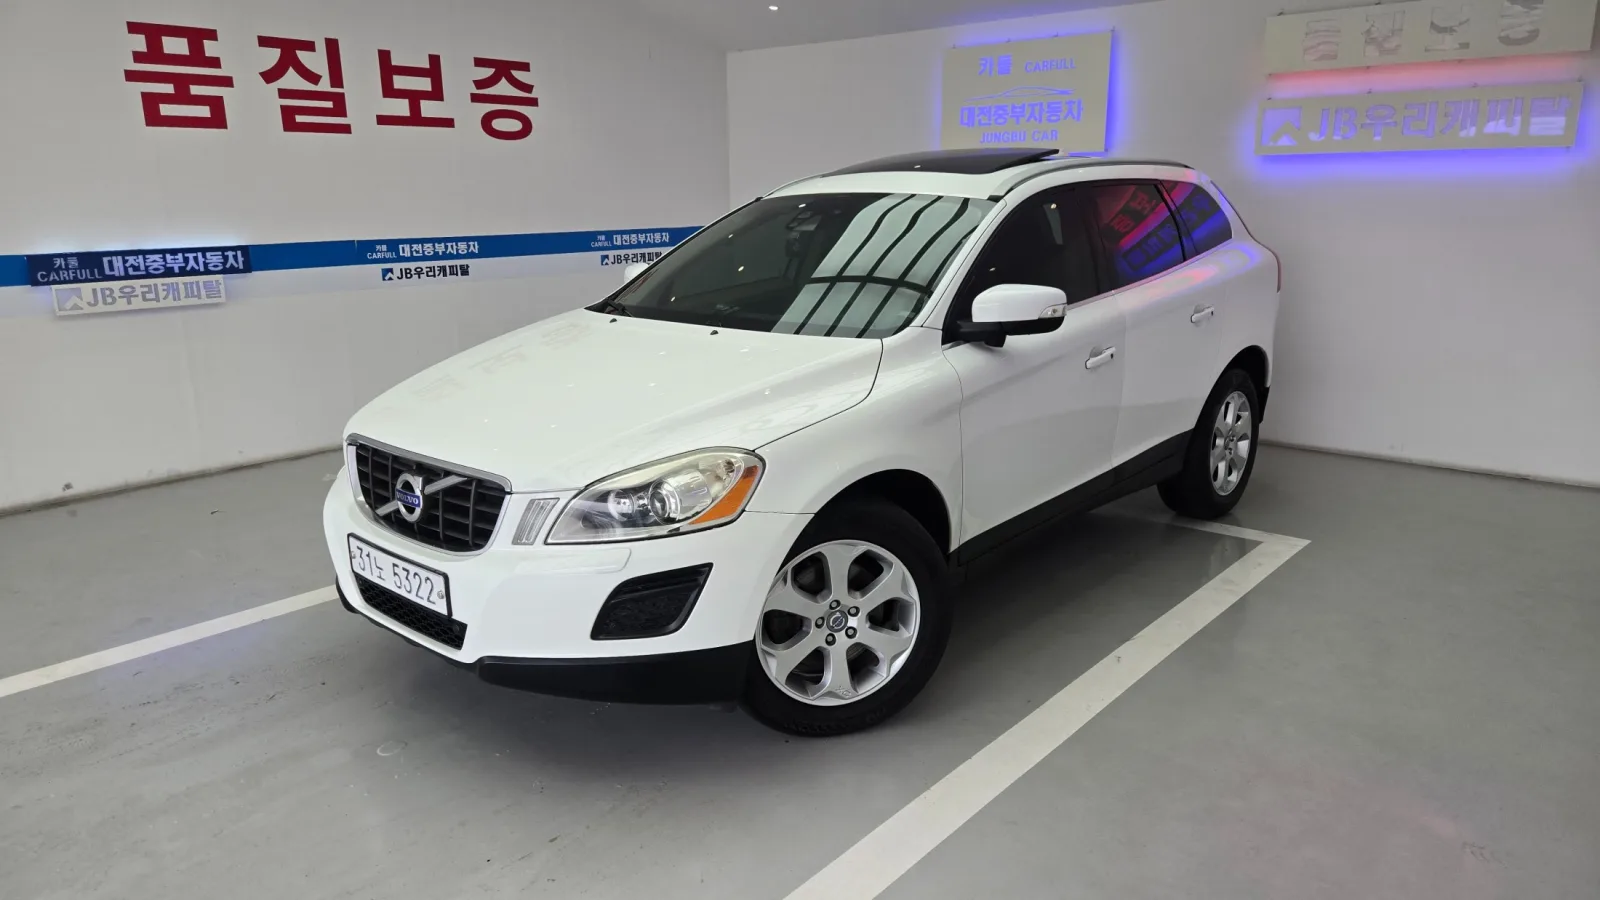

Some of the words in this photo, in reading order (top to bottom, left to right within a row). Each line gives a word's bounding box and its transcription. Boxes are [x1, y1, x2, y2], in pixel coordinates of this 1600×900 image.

[1024, 58, 1077, 73] CARFULL
[124, 21, 539, 140] 품질보증
[960, 98, 1083, 128] 대전중부자동차
[1308, 96, 1573, 141] JB우리캐피탈
[979, 130, 1026, 143] JUNGBU
[1031, 129, 1059, 142] CAR
[613, 232, 670, 246] 대전중부자동차
[367, 251, 397, 259] CARFULL
[399, 241, 479, 257] 대전중부자동차
[103, 250, 244, 277] 대전중부자동차
[37, 268, 103, 282] CARFULL
[397, 264, 470, 280] JB우리캐피탈
[87, 279, 222, 307] JB우리캐피탈
[396, 491, 419, 505] VOLVO
[356, 546, 386, 582] 31노
[392, 562, 436, 605] 5322
